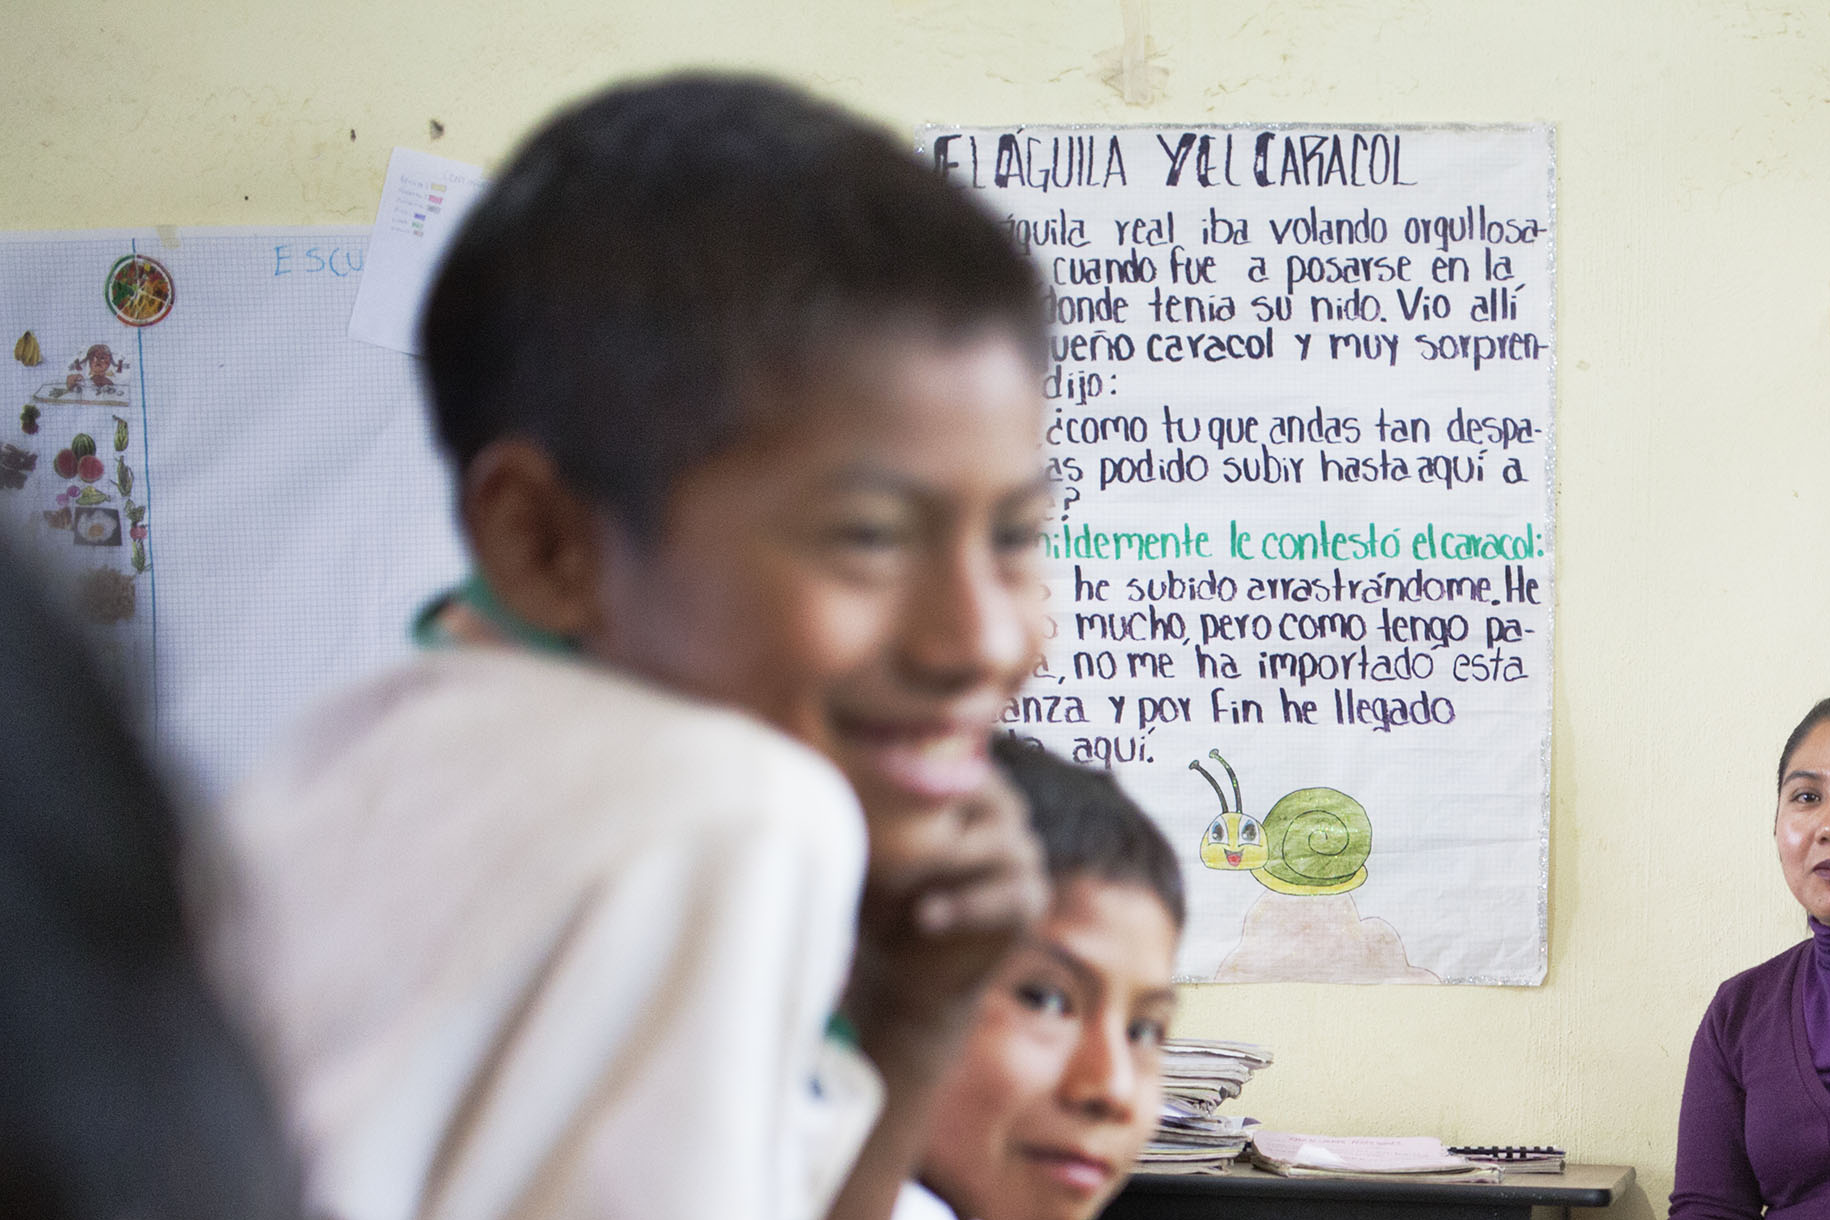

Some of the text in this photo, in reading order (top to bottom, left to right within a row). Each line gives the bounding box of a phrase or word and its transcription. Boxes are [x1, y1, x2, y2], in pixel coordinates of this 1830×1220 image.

[994, 127, 1127, 193] ÁGUILA
[1156, 132, 1197, 187] Y
[1197, 133, 1241, 188] EL
[1253, 131, 1417, 187] CARACOL
[1115, 210, 1175, 247] real
[1201, 207, 1253, 245] iba
[1269, 205, 1388, 245] volando
[1404, 204, 1547, 252] orgullosa-
[273, 244, 365, 279] ESCU
[1053, 245, 1515, 295] cuando fue a posarse en la
[1250, 295, 1292, 322] su
[1310, 287, 1388, 322] nido.
[1396, 286, 1451, 321] Vio
[1470, 283, 1526, 322] allí
[1051, 329, 1136, 362] ueño
[1146, 327, 1273, 362] caracol
[1329, 333, 1399, 366] muy
[1414, 332, 1549, 371] sorpren-
[1208, 416, 1259, 450] que
[1269, 406, 1361, 445] andas
[1375, 408, 1431, 443] tan
[1446, 407, 1543, 450] despa-
[1099, 448, 1209, 490] podido
[1223, 443, 1305, 484] subir
[1320, 449, 1411, 483] hasta
[1417, 449, 1489, 490] aquí
[1502, 456, 1529, 484] a
[1037, 519, 1545, 561] ildemente le contestó el caracol:
[1074, 564, 1111, 601] he
[1126, 569, 1238, 601] subido
[1246, 567, 1501, 606] arrastrándome.
[1504, 564, 1542, 604] He
[1075, 603, 1191, 646] mucho,
[1199, 611, 1272, 645] pero
[1278, 612, 1367, 641] como
[1376, 607, 1469, 650] tengo
[1486, 614, 1536, 649] pa-
[1073, 650, 1118, 680] no
[1126, 651, 1176, 679] me
[1194, 643, 1241, 679] ha
[1258, 644, 1434, 687] importado
[1453, 646, 1529, 682] esta
[1138, 696, 1192, 730] por
[1279, 687, 1318, 724] he
[1334, 687, 1456, 733] llegado
[1072, 726, 1156, 770] aquí.
